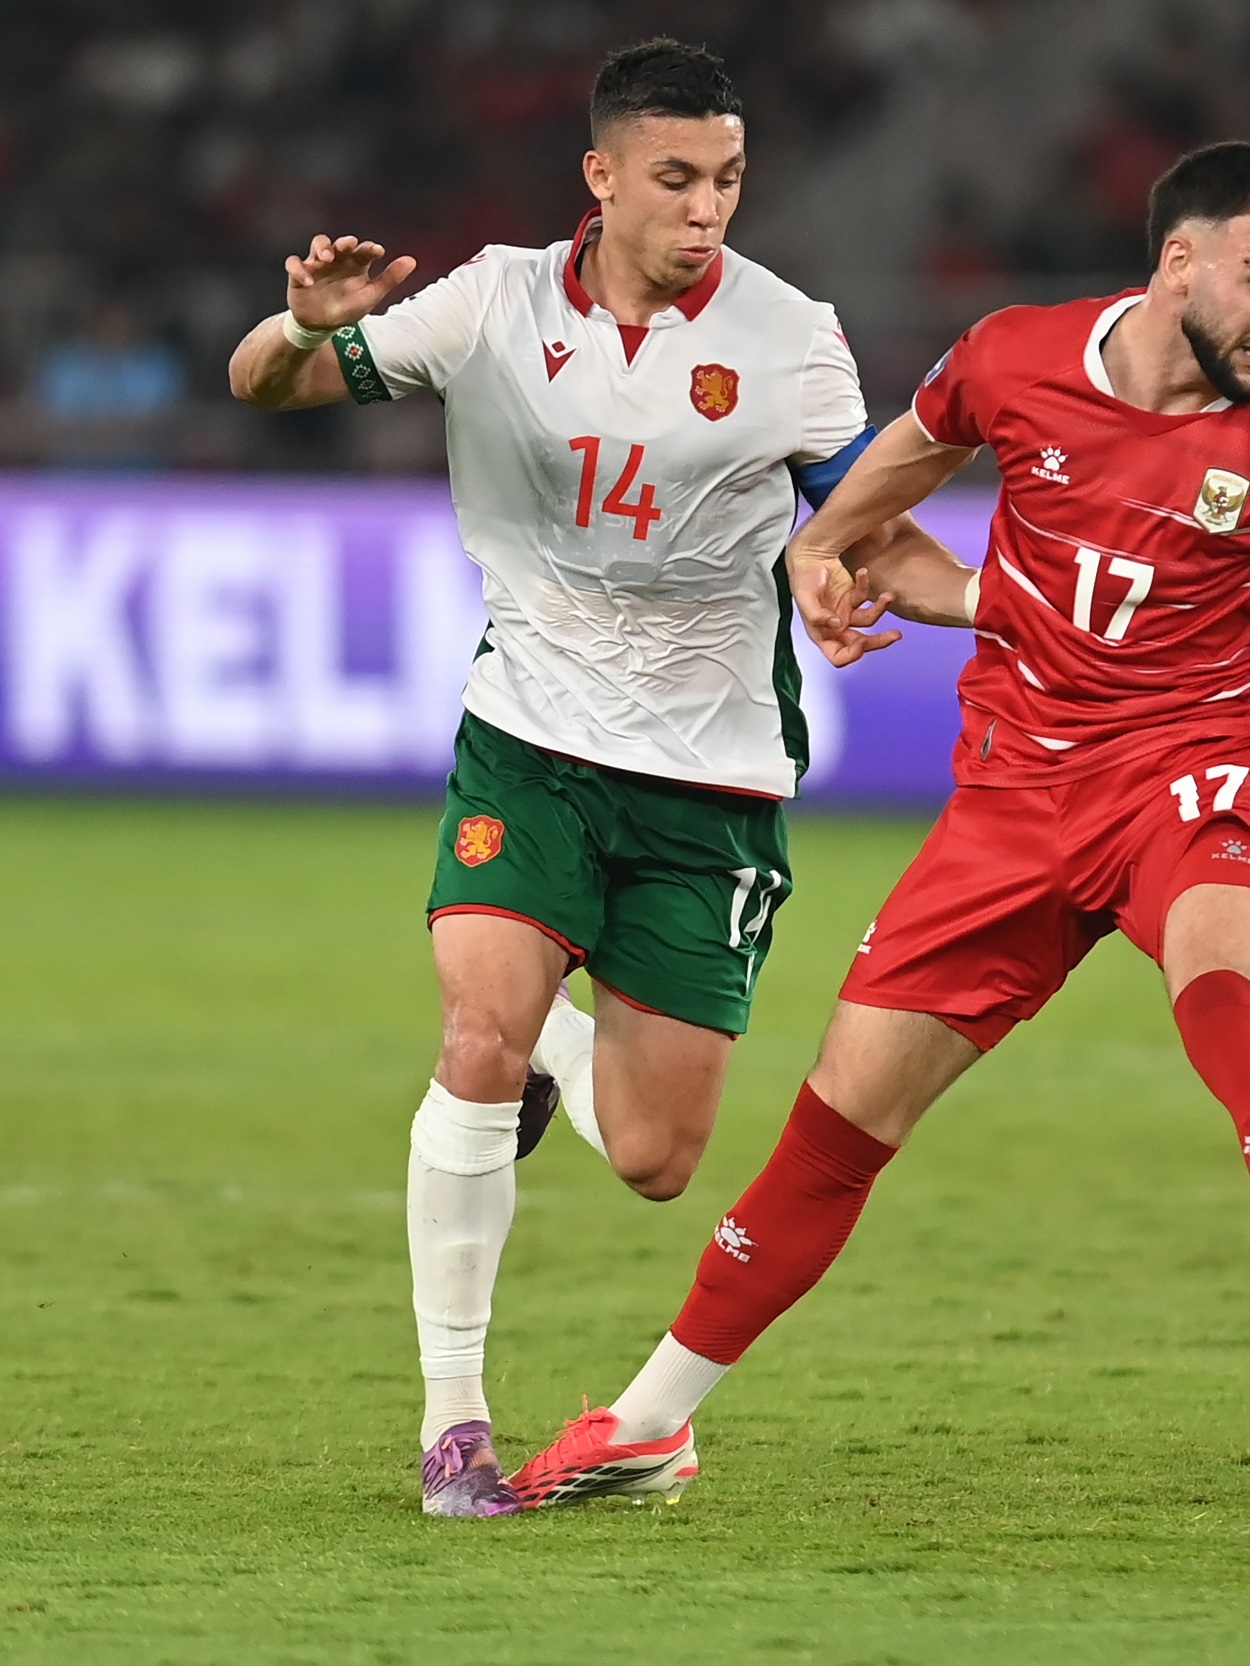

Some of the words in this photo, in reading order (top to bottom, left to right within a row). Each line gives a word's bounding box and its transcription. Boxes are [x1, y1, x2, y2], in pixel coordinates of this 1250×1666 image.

[568, 435, 662, 541] 14
[1031, 466, 1070, 485] KELME
[1073, 546, 1155, 641] 17
[1169, 763, 1250, 822] 17
